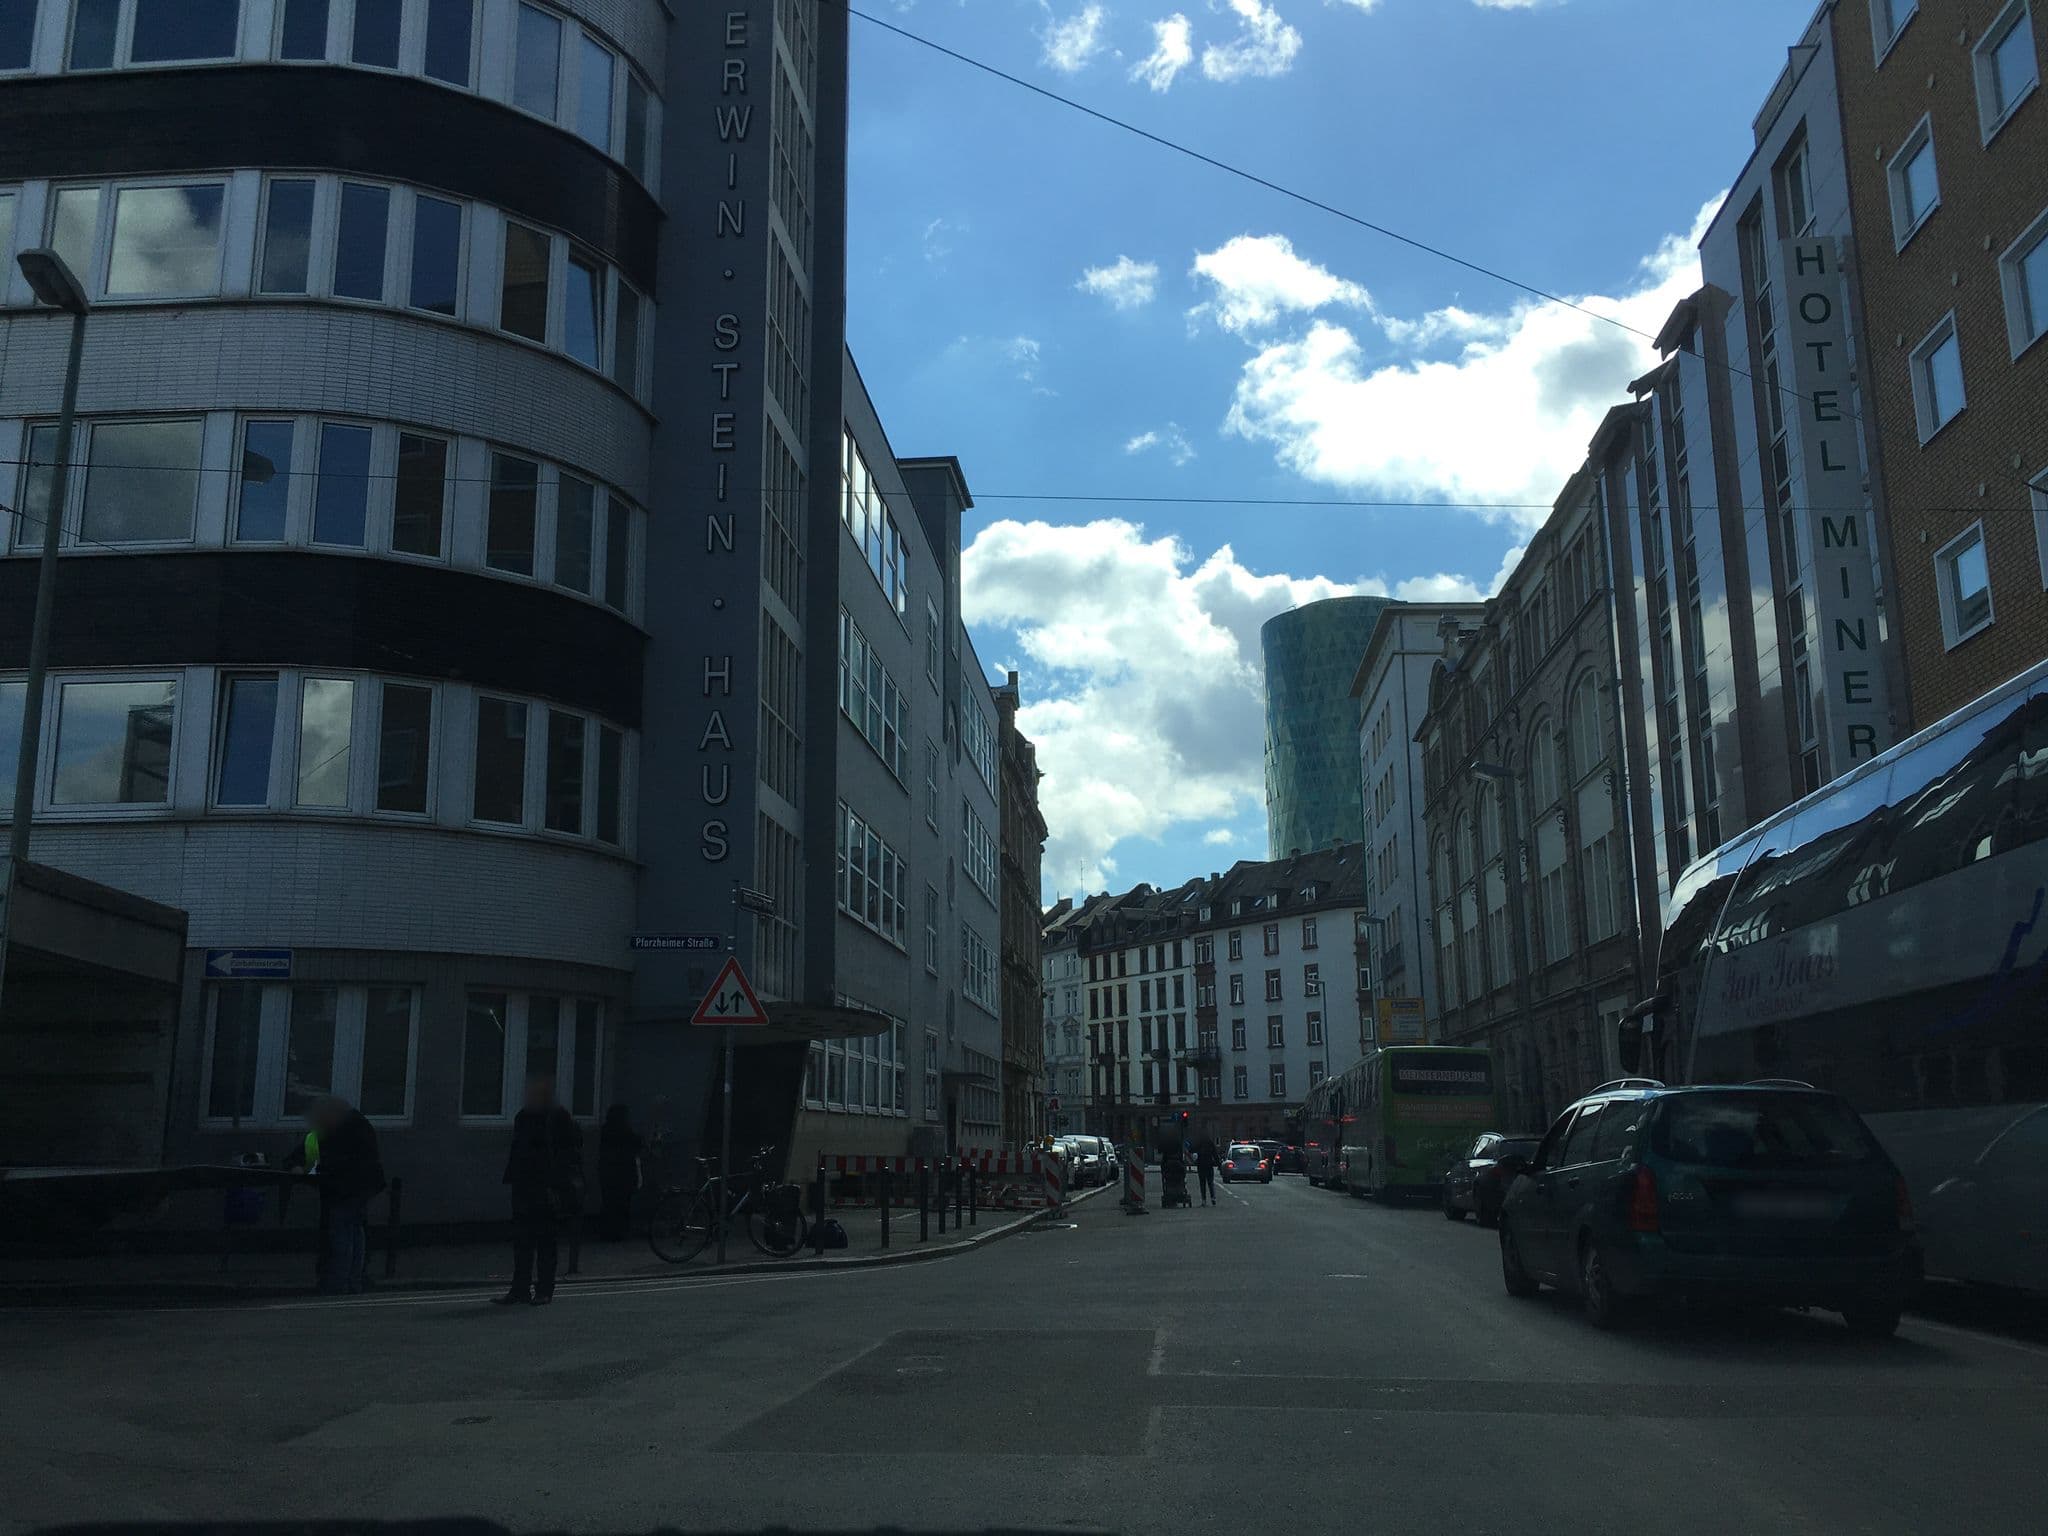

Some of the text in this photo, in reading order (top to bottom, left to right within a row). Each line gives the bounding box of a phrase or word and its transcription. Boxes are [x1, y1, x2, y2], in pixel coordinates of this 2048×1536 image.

[698, 11, 752, 861] ERWIN STEIN HAUS
[1795, 244, 1878, 758] HOTEL MINER
[635, 936, 714, 949] Pforzheimer Straße
